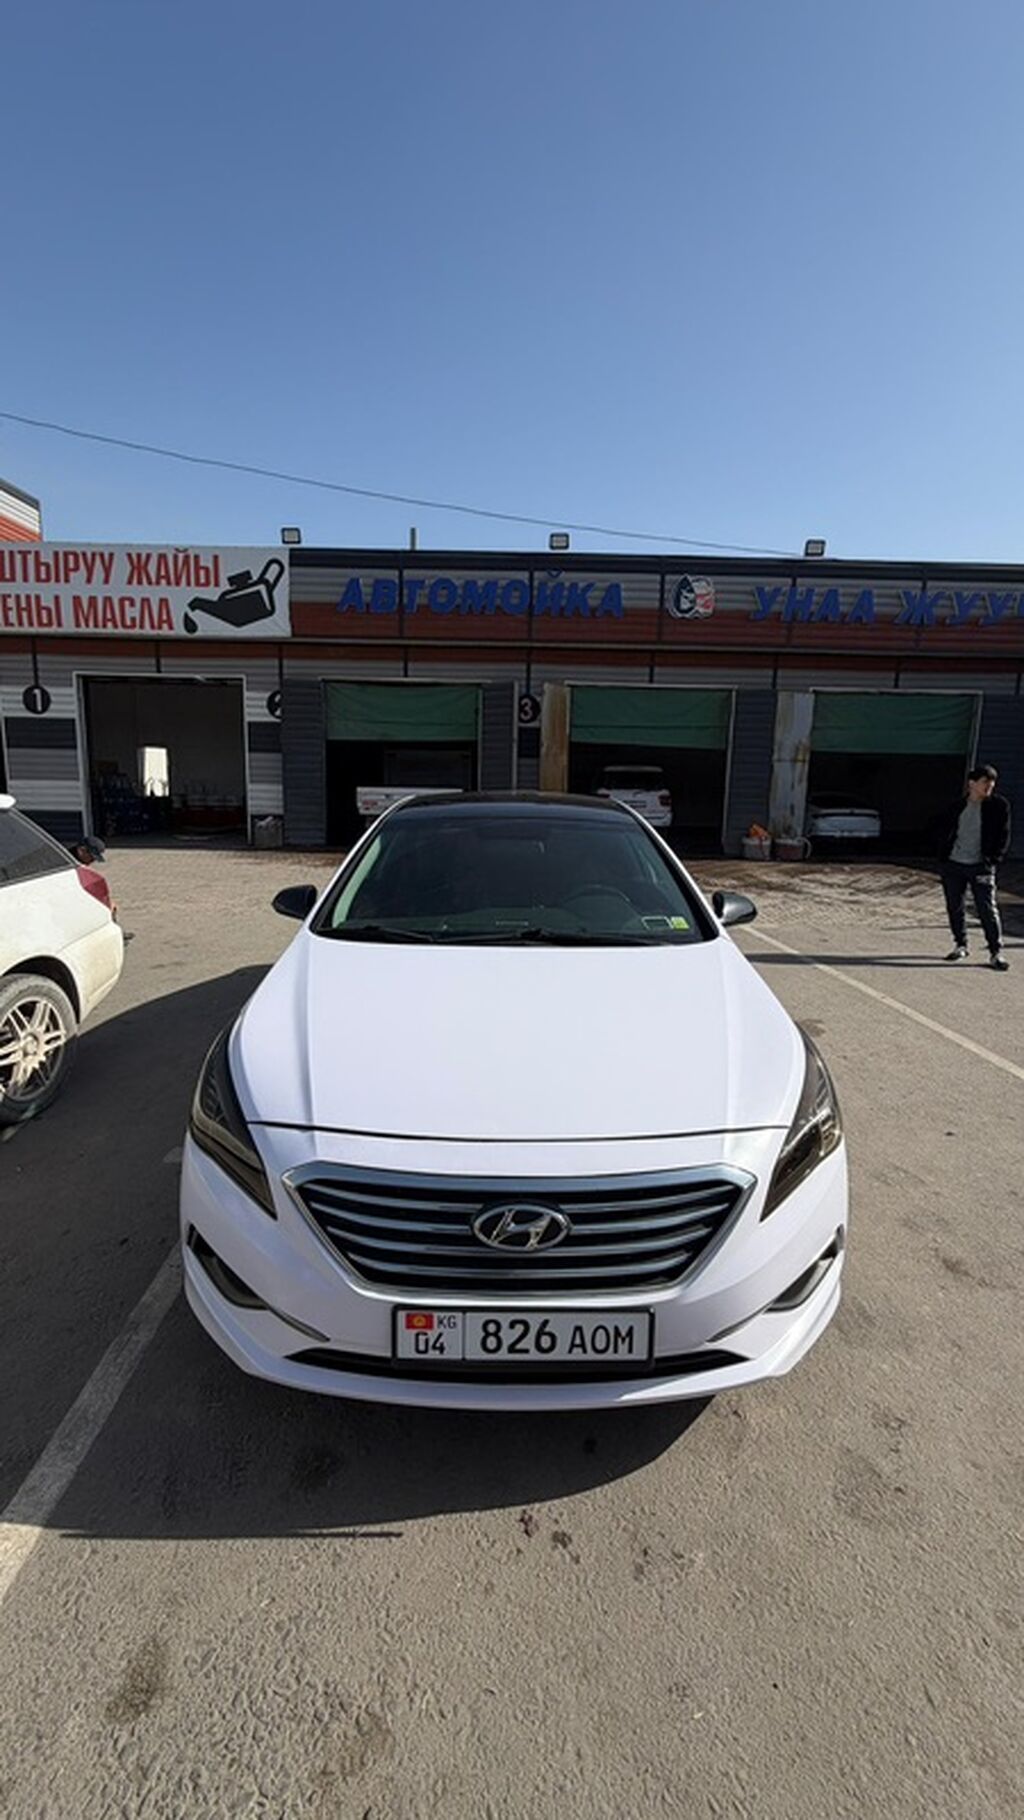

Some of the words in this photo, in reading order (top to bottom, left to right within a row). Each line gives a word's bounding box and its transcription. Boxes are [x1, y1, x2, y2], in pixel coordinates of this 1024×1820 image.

[126, 547, 220, 588] ЖАЙЫ
[336, 567, 624, 617] АВТОМОЙКА
[752, 586, 874, 625] УНАА
[895, 590, 1024, 626] ЖУУ
[0, 594, 63, 628] ЕНЫ
[72, 595, 175, 631] МАСЛА
[33, 688, 43, 711] 1
[519, 697, 533, 721] 3
[437, 1315, 456, 1328] KG
[480, 1319, 557, 1353] 826
[414, 1332, 446, 1354] 04
